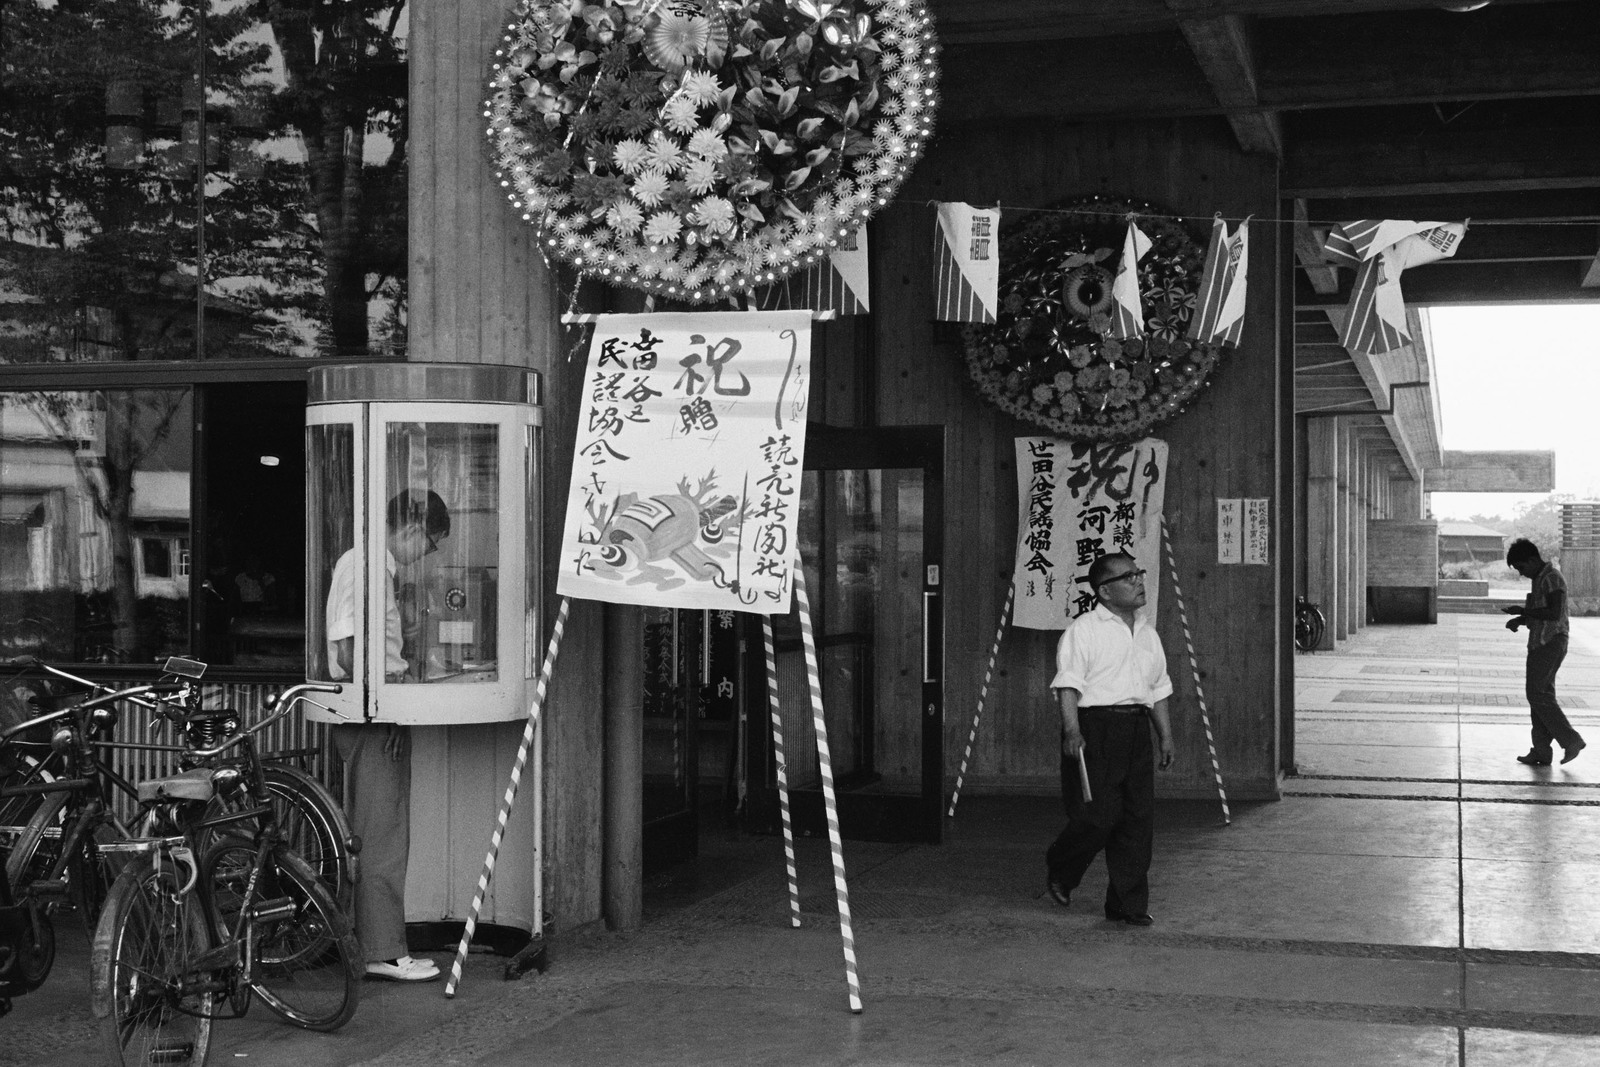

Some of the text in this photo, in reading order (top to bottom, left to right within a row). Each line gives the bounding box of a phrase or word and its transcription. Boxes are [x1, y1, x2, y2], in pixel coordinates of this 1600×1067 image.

[673, 334, 751, 396] 祝
[1067, 440, 1134, 501] 祝
[1221, 503, 1234, 558] 駐車禁止
